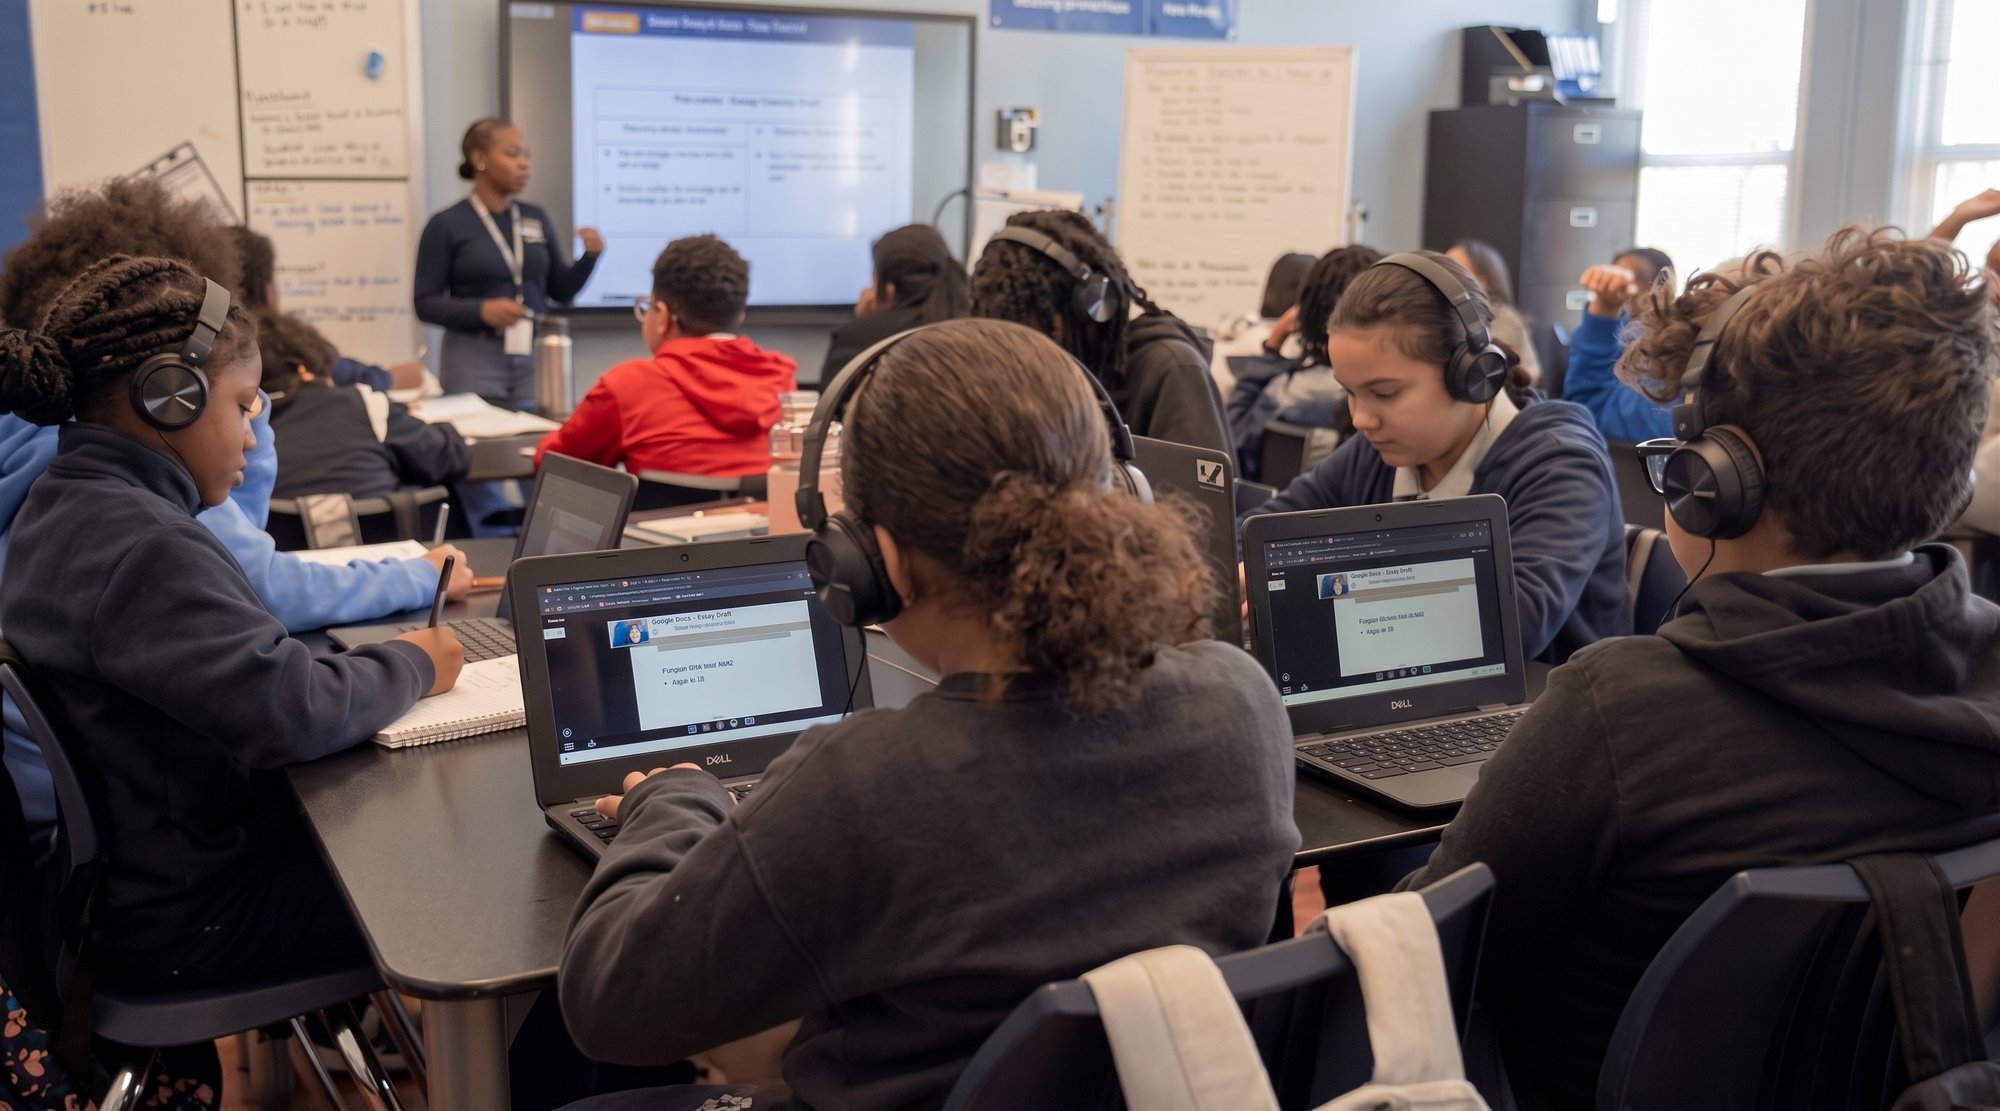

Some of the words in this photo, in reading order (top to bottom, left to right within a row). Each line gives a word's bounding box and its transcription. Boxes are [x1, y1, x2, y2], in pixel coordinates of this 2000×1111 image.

[651, 616, 674, 626] Google
[697, 613, 715, 621] Essay
[1391, 699, 1412, 709] DELL
[706, 754, 732, 765] DELL
